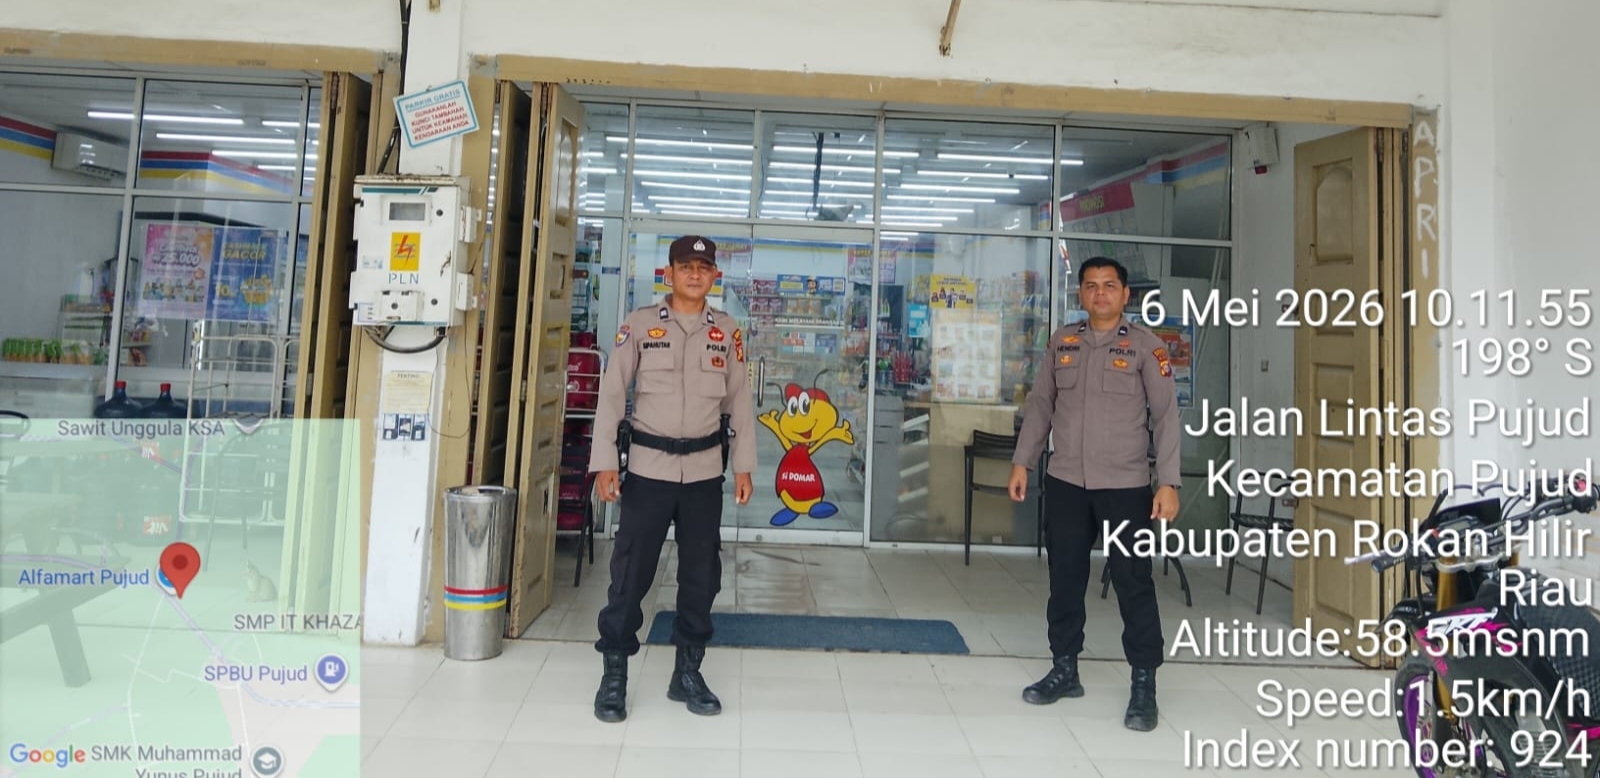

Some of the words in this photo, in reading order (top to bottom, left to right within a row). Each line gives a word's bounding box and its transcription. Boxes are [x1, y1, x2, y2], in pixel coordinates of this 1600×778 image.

[405, 97, 433, 110] PARKIR
[433, 89, 461, 102] GRATIS
[411, 115, 431, 127] KUNCI
[432, 106, 465, 120] TAMBAHAN
[415, 101, 457, 118] GUNAKANLAH
[411, 123, 433, 135] UNTUK
[434, 112, 468, 127] KEAMANAN
[414, 126, 452, 141] KENDARAAN
[452, 119, 469, 131] ANDA
[388, 272, 419, 285] PLN
[706, 344, 727, 353] POLRI
[1109, 347, 1136, 357] POLRI
[788, 471, 816, 483] DOMAR
